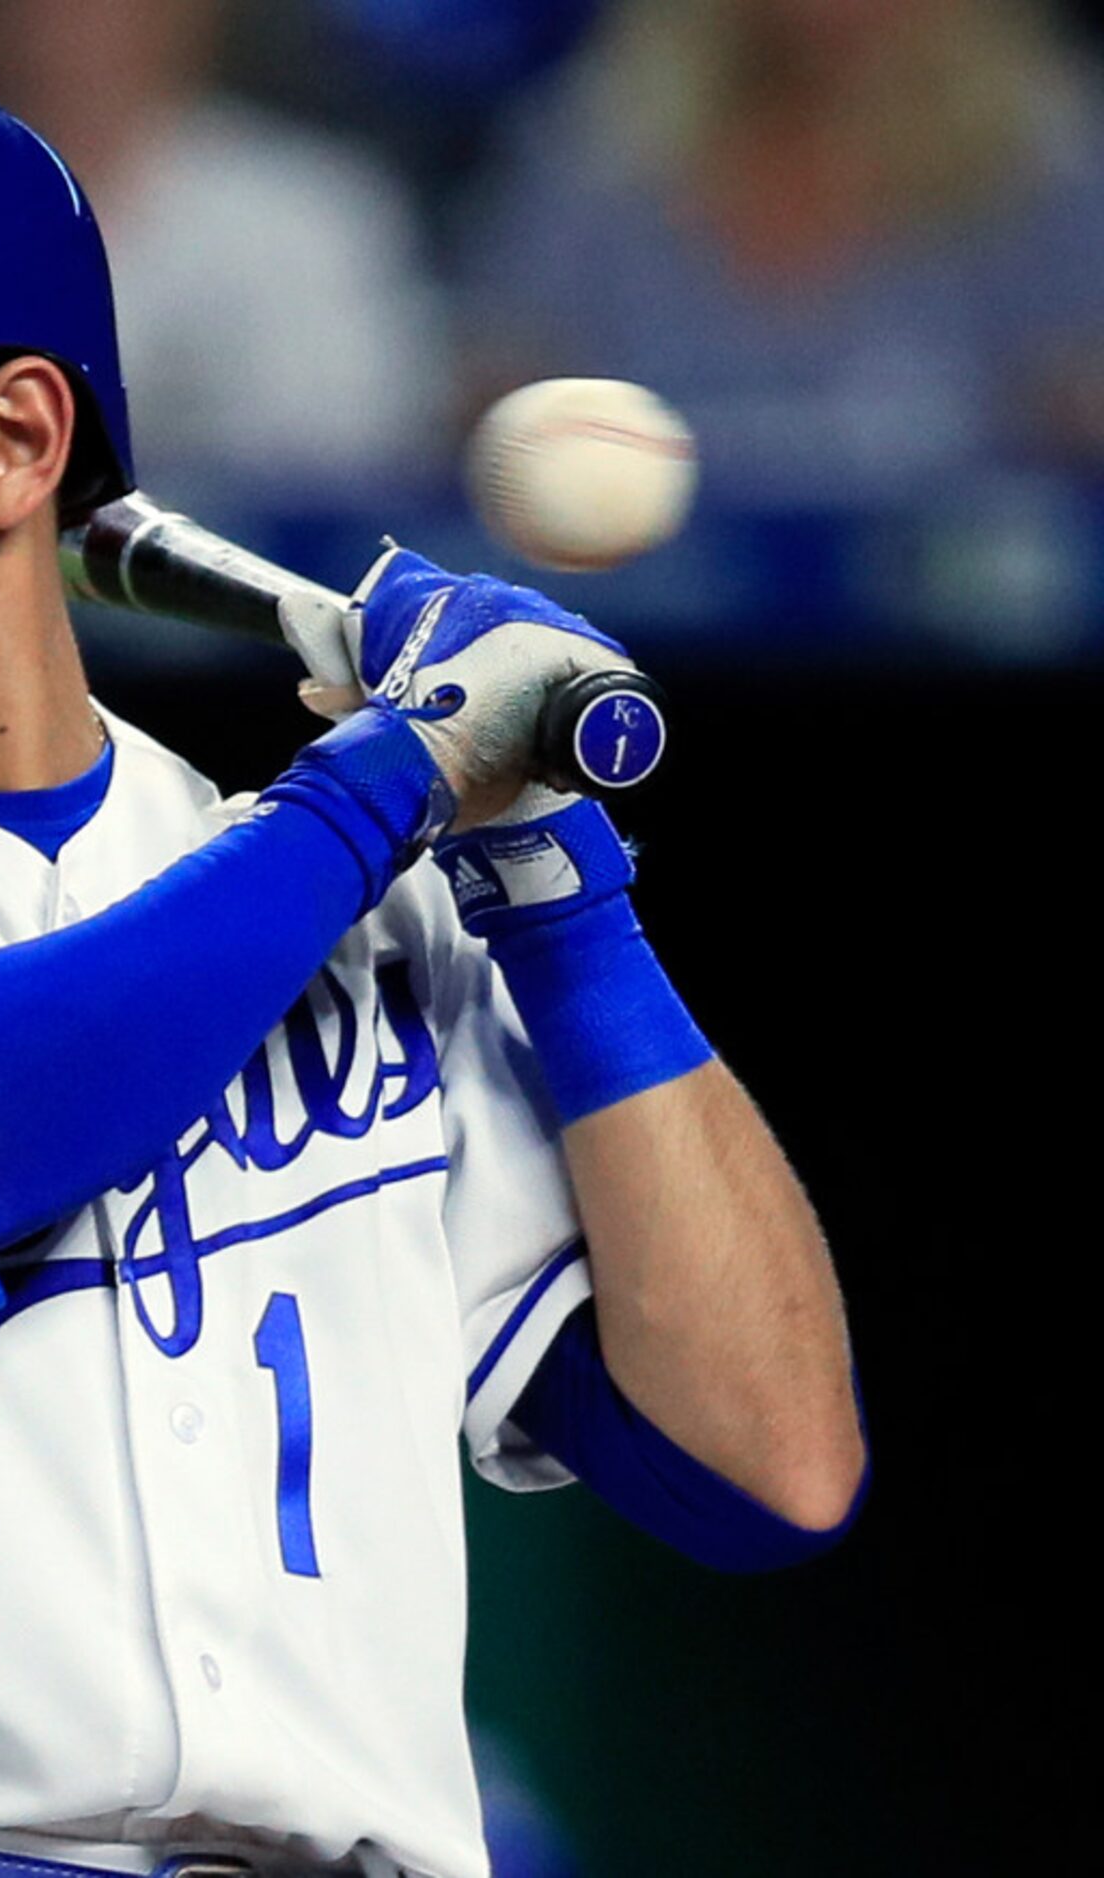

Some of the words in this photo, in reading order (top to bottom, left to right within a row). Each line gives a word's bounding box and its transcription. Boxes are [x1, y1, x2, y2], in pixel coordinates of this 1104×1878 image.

[612, 698, 641, 729] KC
[612, 734, 627, 774] 1
[254, 1291, 322, 1577] 1
